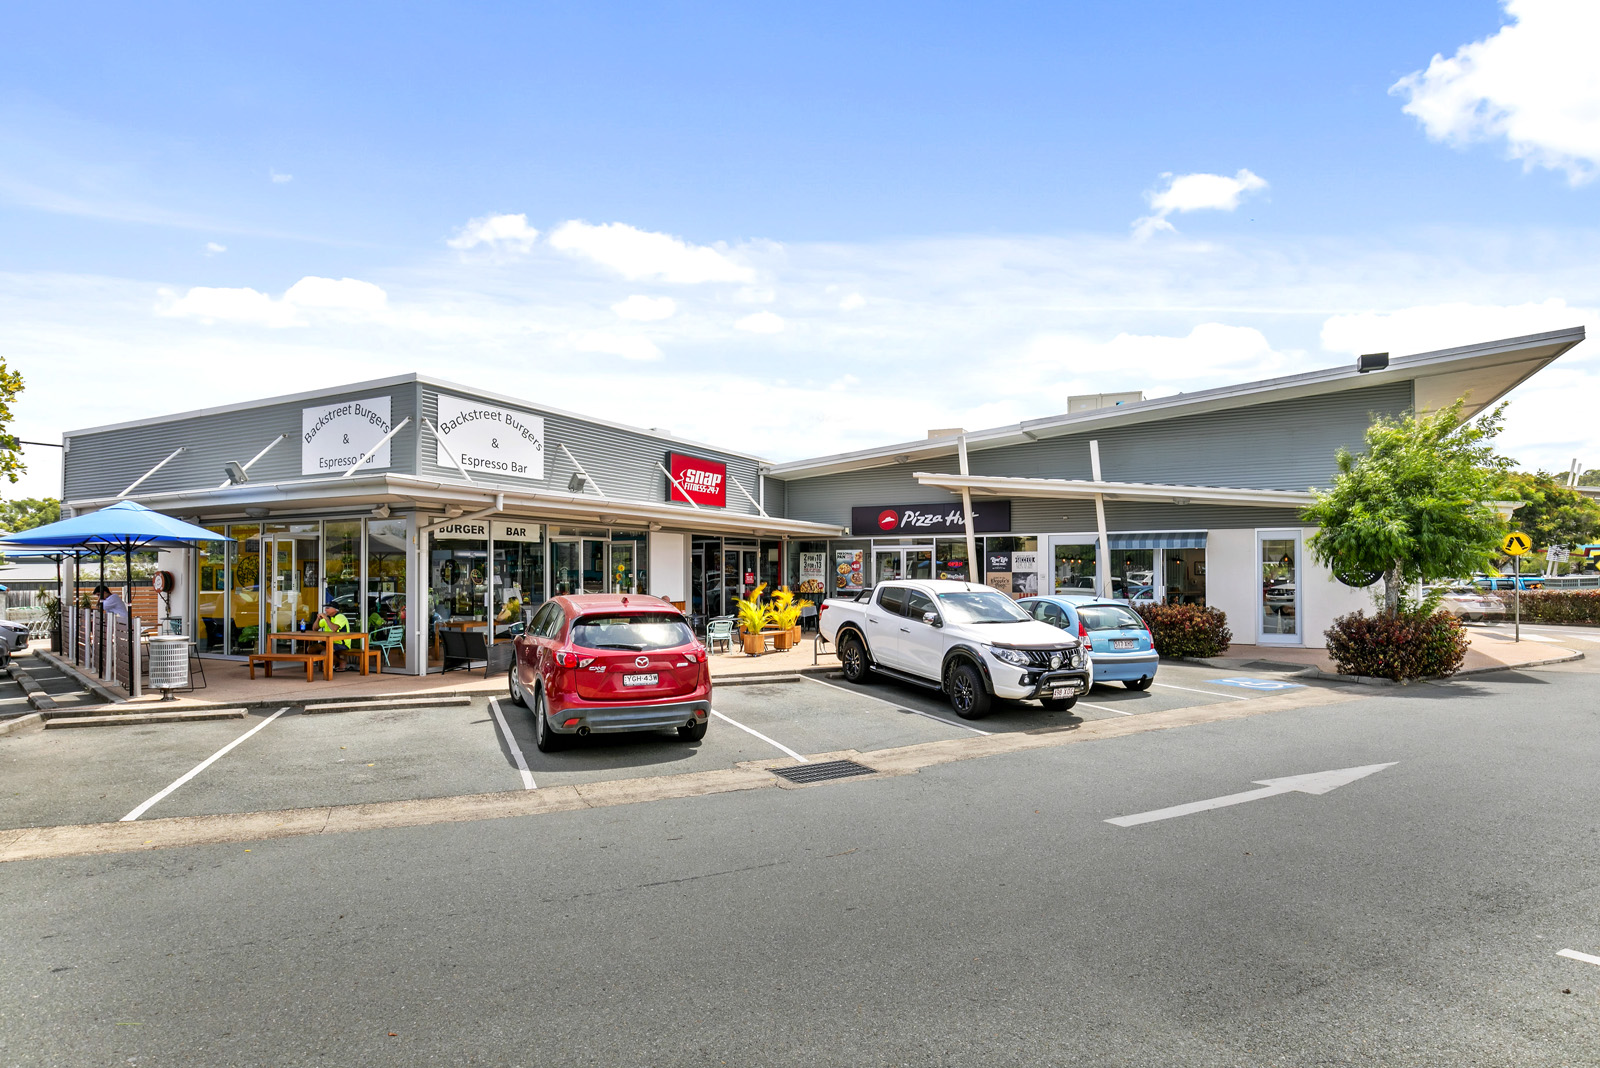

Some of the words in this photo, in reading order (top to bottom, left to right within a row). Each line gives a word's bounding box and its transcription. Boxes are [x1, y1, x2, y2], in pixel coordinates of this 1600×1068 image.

[304, 404, 352, 444] Backstreet
[354, 404, 390, 434] Burgers
[440, 410, 502, 435] Backstreet
[505, 414, 543, 452] Burgers
[342, 434, 350, 444] &
[491, 438, 500, 449] &
[319, 456, 358, 470] Espresso
[461, 453, 508, 471] Espresso
[511, 462, 528, 474] Bar
[900, 510, 944, 528] Pizza
[438, 524, 485, 534] BURGER
[506, 527, 526, 536] BAR
